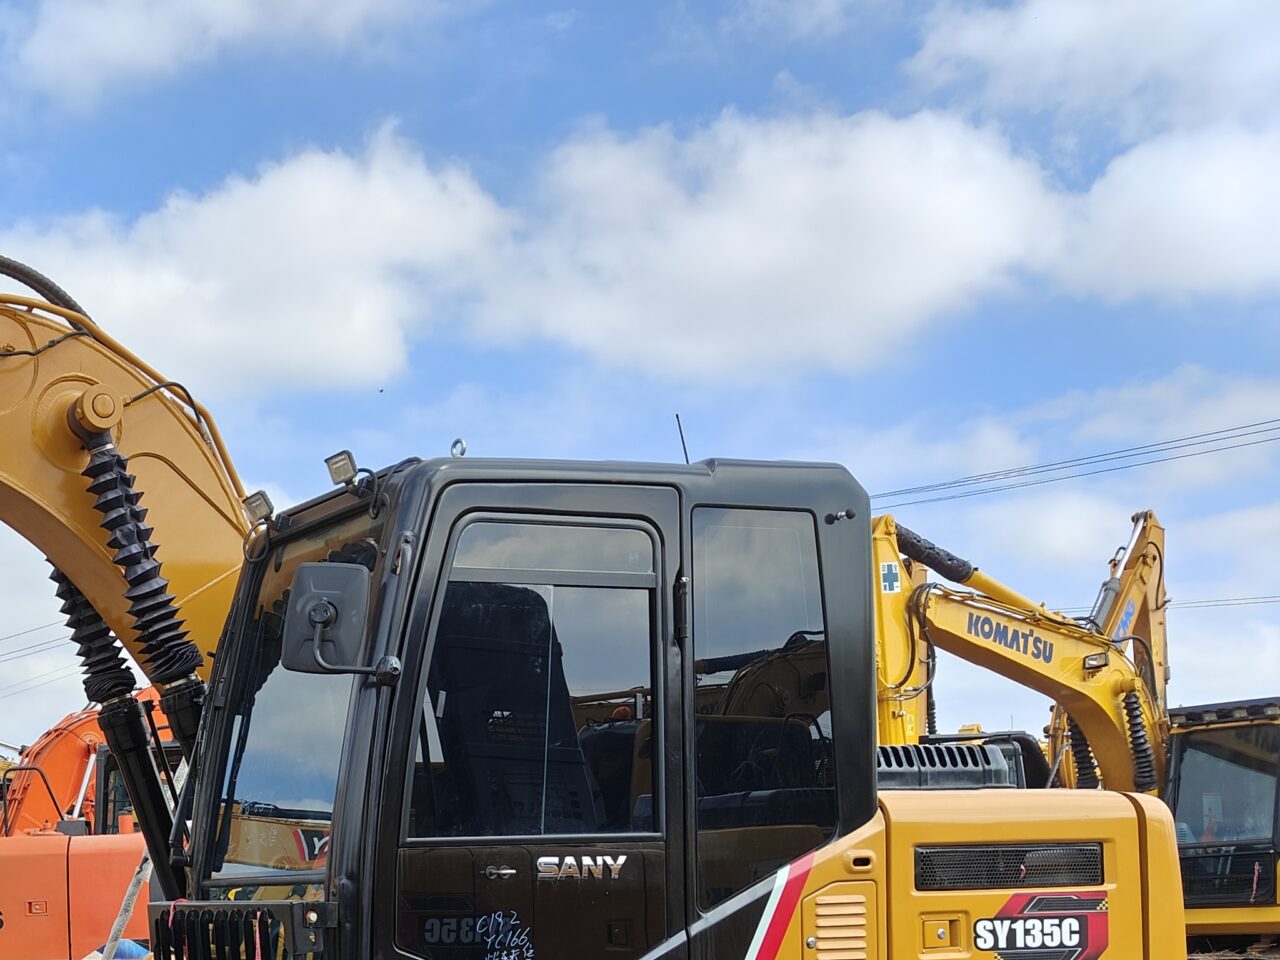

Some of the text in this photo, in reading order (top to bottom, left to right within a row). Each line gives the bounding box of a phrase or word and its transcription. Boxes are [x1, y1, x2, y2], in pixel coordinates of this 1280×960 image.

[967, 612, 1054, 664] KOMATSU
[536, 855, 627, 879] SANY
[483, 926, 531, 950] YC166
[974, 917, 1081, 949] SY135C
